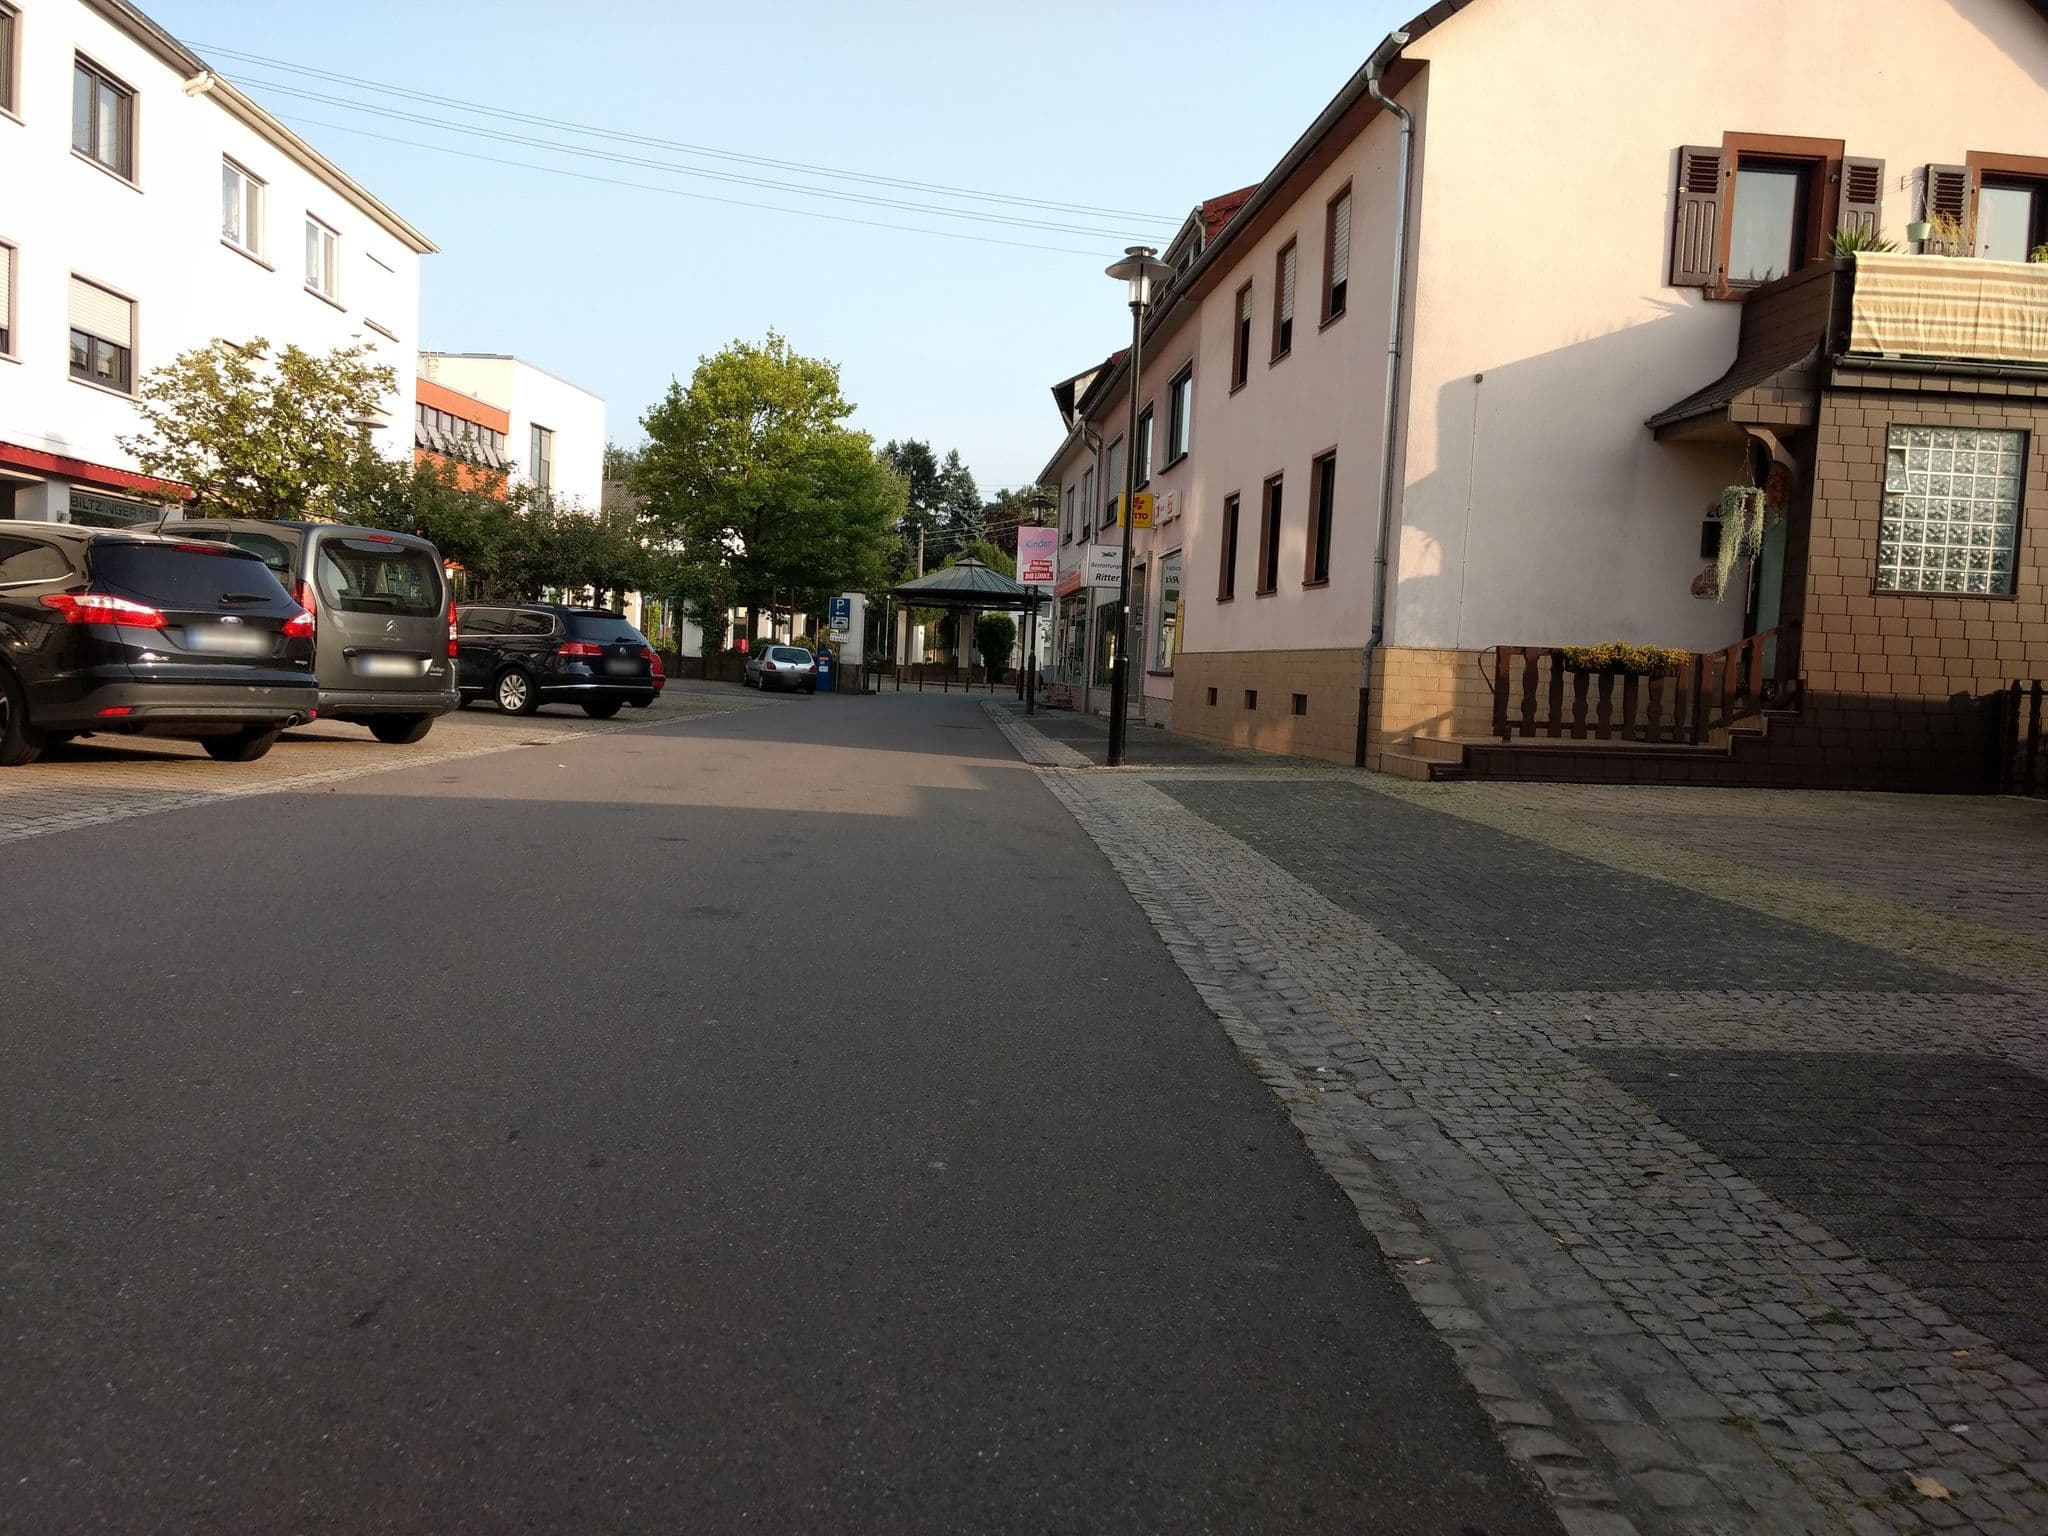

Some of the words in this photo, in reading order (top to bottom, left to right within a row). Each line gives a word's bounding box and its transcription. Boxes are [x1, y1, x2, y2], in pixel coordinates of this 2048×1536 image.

[1132, 512, 1148, 520] TTO
[1025, 539, 1053, 548] Kinder
[1095, 573, 1121, 582] Ritter
[836, 599, 845, 610] P
